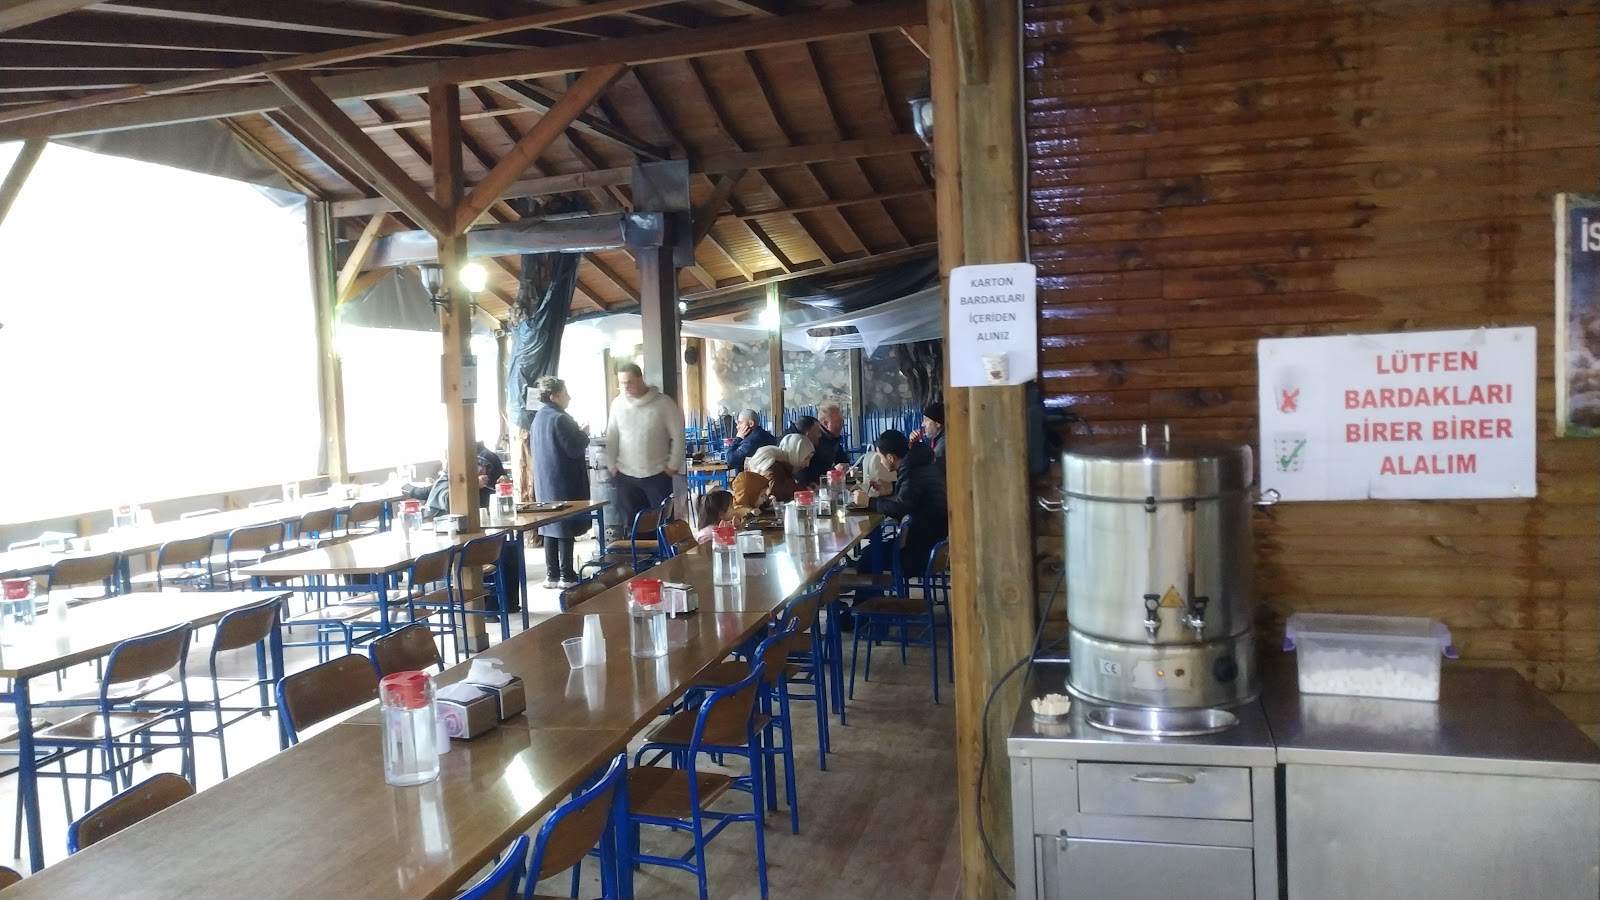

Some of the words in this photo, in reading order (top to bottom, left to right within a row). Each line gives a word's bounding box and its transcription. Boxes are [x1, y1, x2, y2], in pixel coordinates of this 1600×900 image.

[970, 277, 1014, 288] KARTON
[960, 293, 1025, 306] BARDAKLARI
[969, 312, 1016, 324] İÇERİDEN
[977, 331, 1010, 341] ALINIZ
[1376, 350, 1478, 374] LÜTFEN
[1344, 384, 1512, 409] BARDAKLARI
[1345, 417, 1423, 443] BİRER
[1432, 415, 1513, 441] BİRER
[1380, 454, 1477, 475] ALALIM
